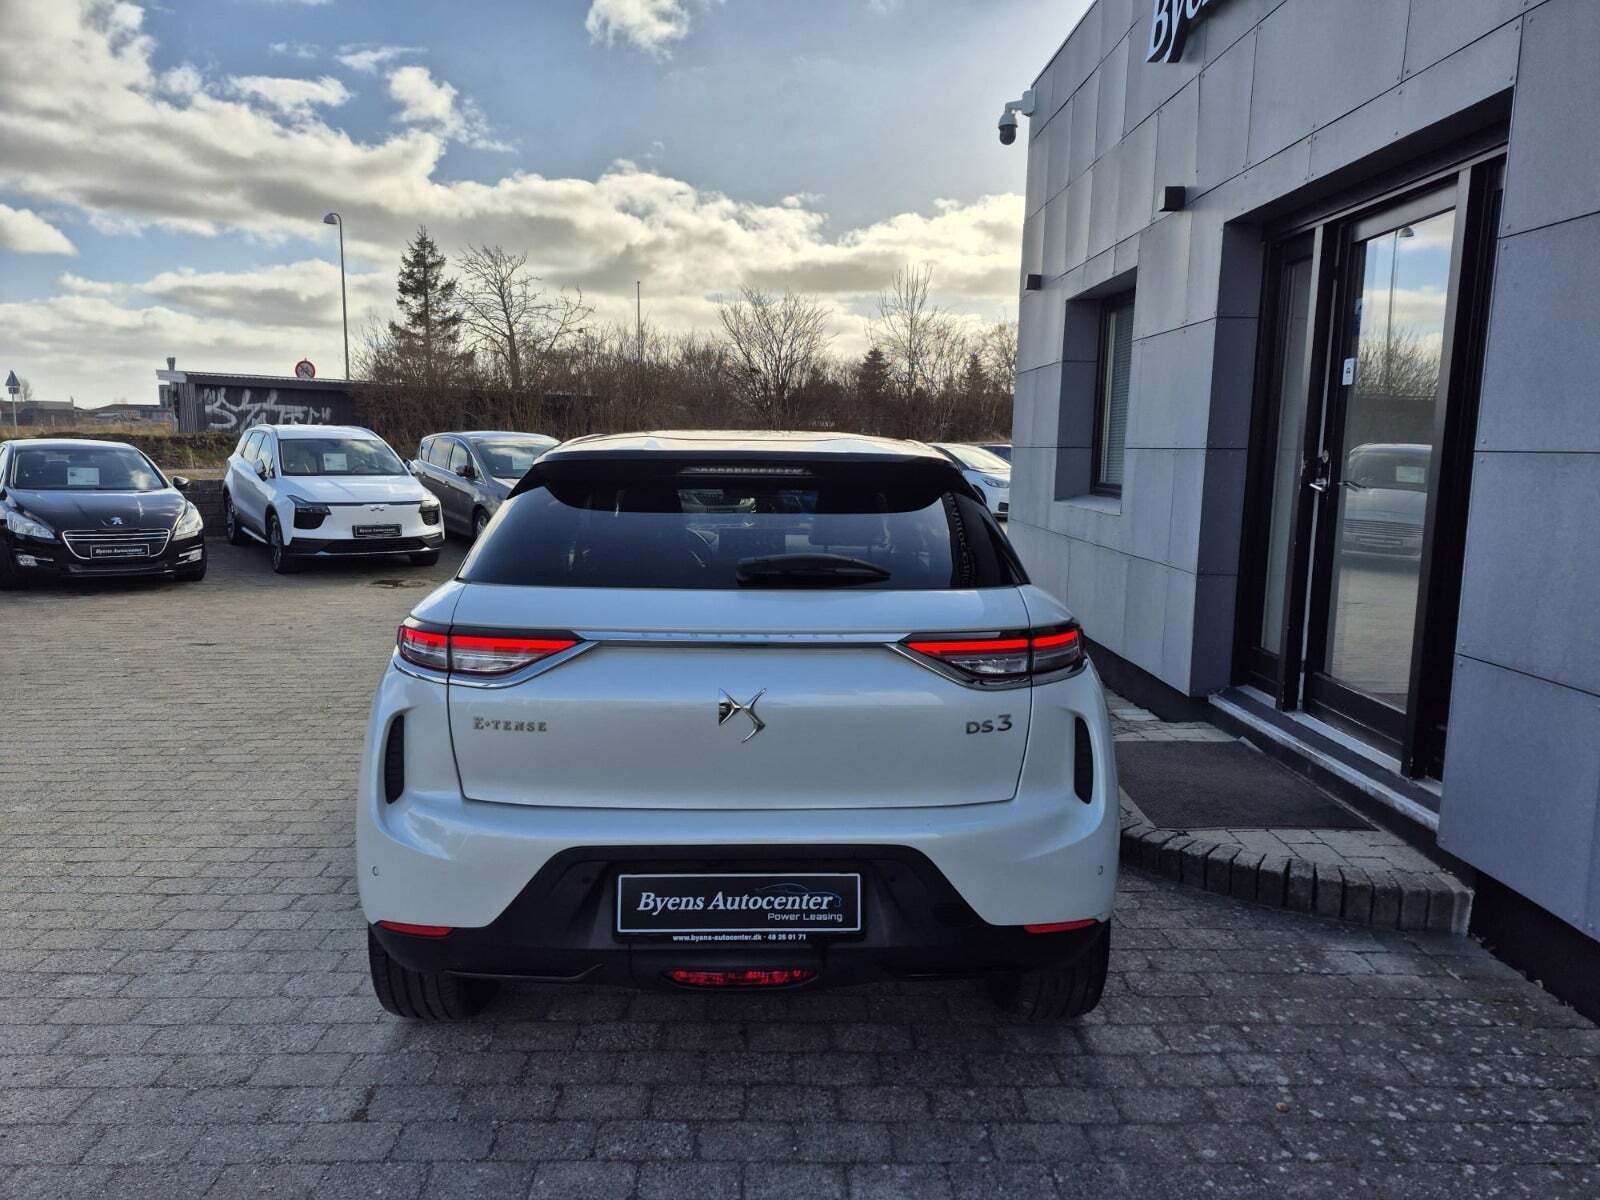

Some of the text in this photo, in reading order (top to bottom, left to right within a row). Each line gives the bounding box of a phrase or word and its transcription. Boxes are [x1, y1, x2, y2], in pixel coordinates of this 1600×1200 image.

[636, 891, 834, 916] Byens Autocenter
[767, 912, 843, 923] Power Leasing
